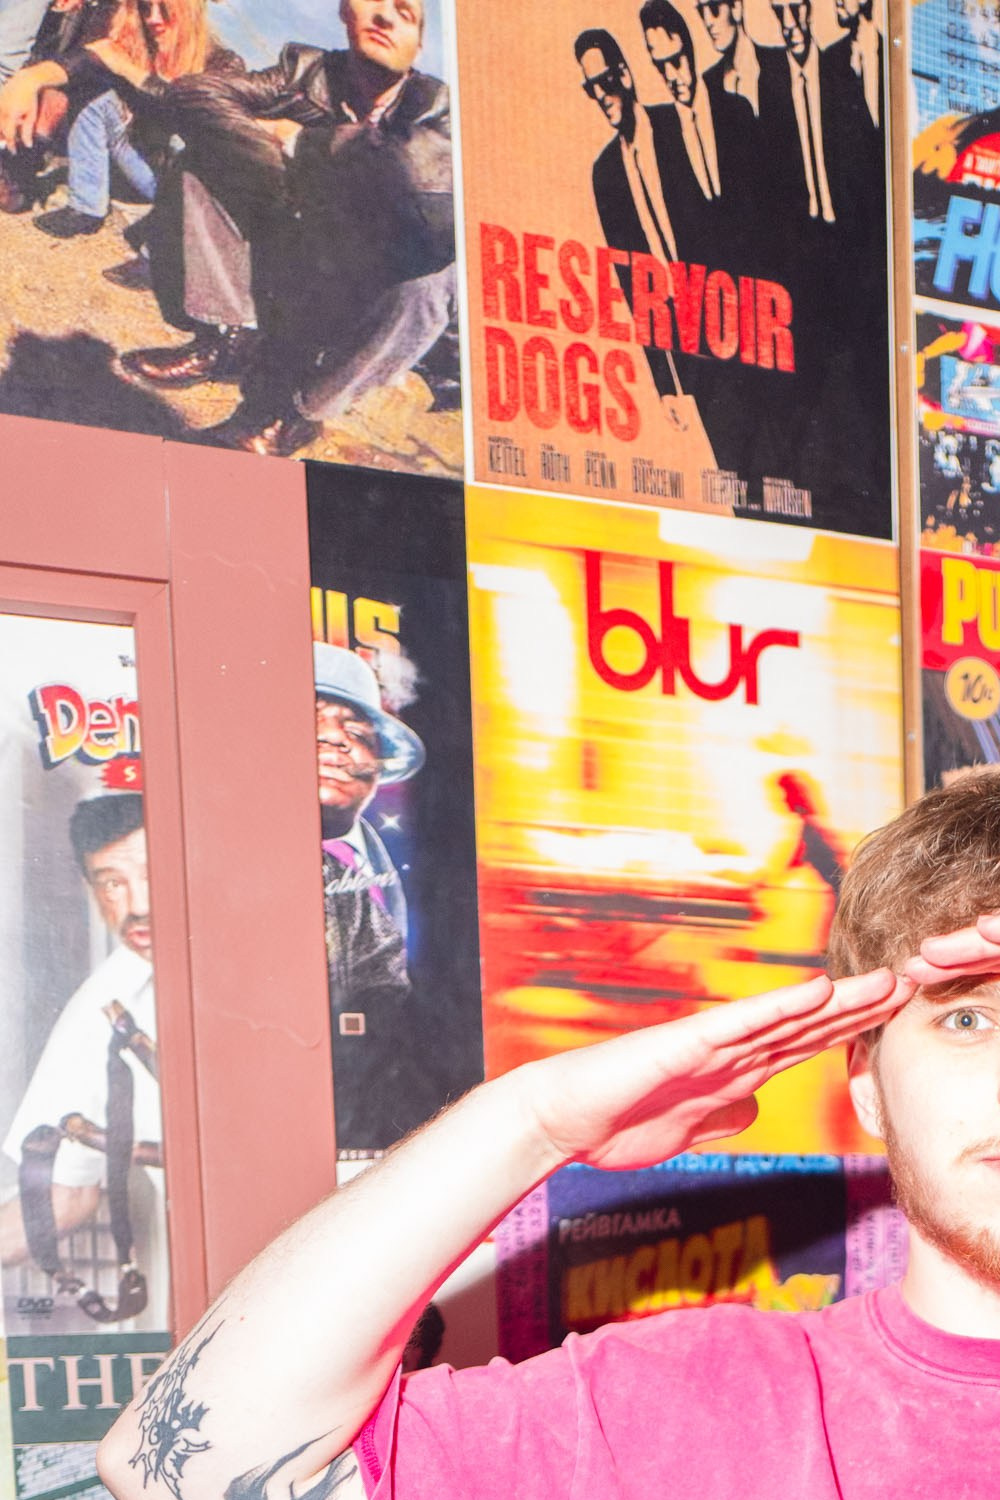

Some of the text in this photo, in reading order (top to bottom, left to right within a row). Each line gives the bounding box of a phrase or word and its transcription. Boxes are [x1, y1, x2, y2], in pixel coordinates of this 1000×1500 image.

[479, 222, 796, 373] RESERVOIR
[484, 326, 642, 442] DOGS
[585, 549, 800, 706] blur
